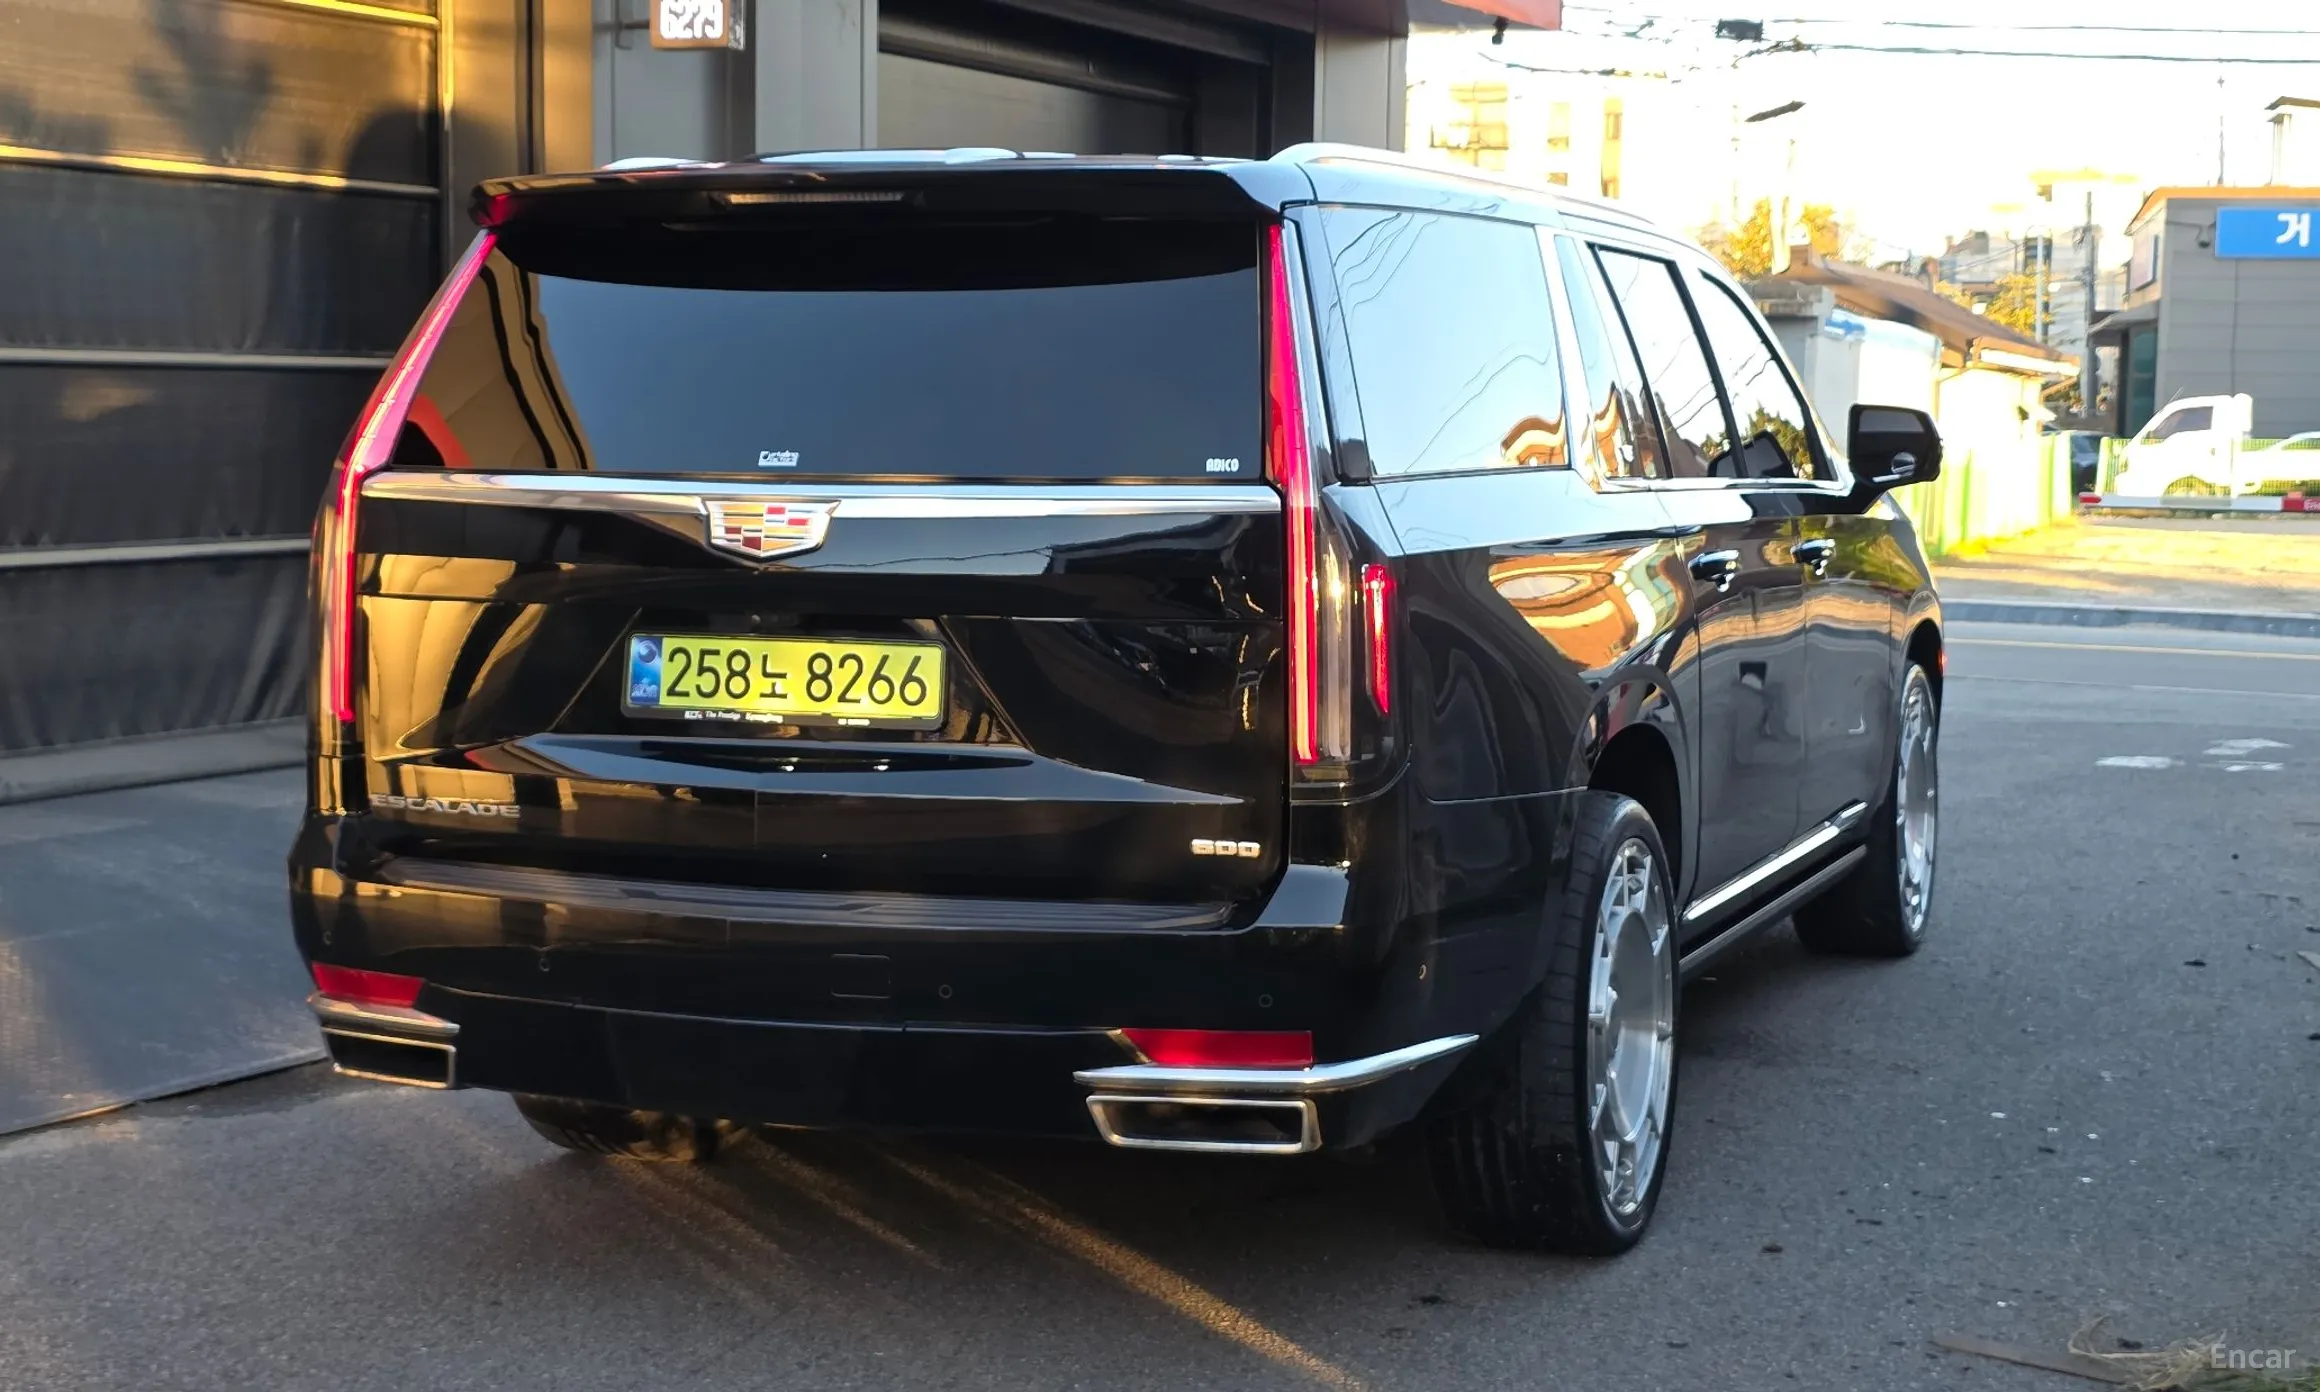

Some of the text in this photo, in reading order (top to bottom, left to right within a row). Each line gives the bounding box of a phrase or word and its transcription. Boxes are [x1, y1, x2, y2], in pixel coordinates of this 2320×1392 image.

[2276, 213, 2310, 248] 거
[666, 647, 927, 706] 258노 8266
[370, 795, 521, 817] ESCALADE
[1191, 839, 1260, 858] 600
